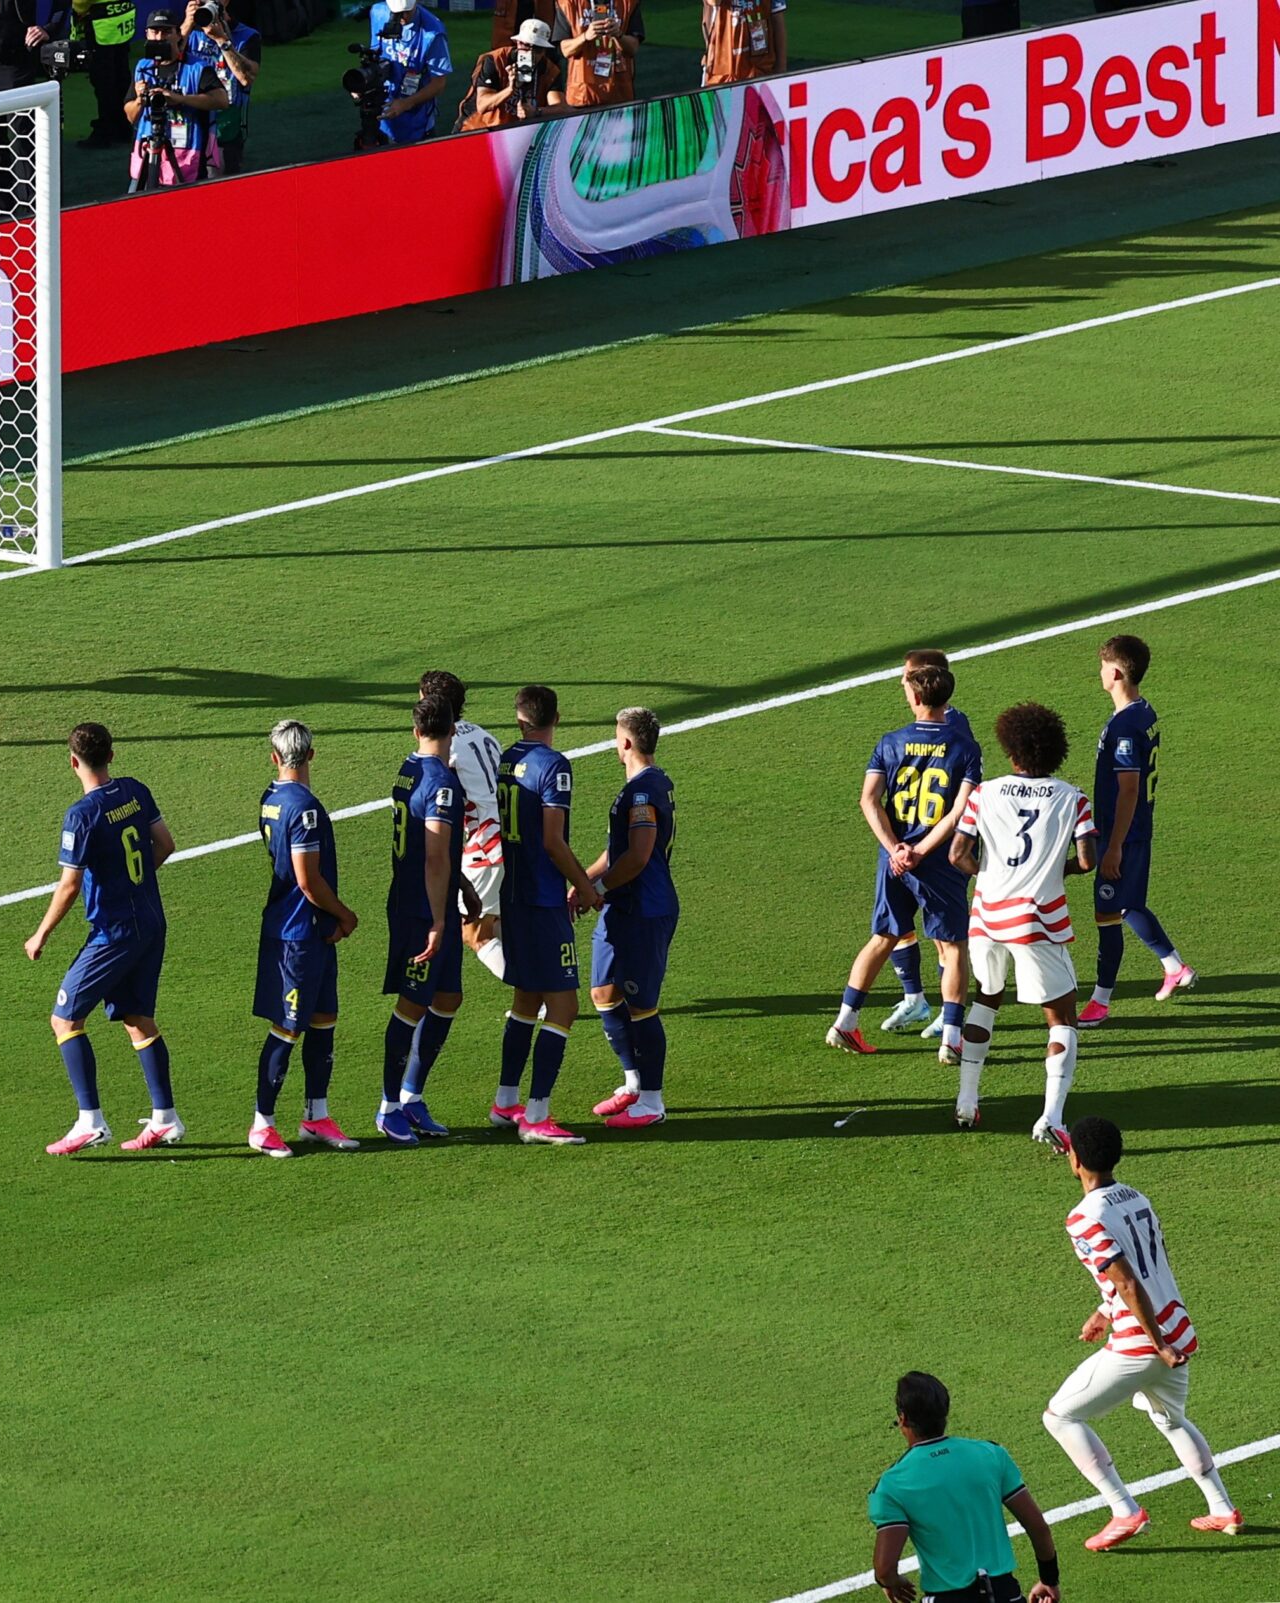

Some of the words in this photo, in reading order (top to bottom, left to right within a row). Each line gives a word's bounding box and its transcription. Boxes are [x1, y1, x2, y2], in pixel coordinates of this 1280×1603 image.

[775, 57, 991, 209] ica's
[1025, 12, 1226, 163] Best
[497, 781, 521, 843] 21
[893, 766, 950, 827] 26
[1000, 783, 1055, 798] RICHARDS
[121, 825, 144, 886] 6
[393, 800, 408, 861] 3
[1007, 808, 1040, 867] 3
[406, 957, 430, 982] 23
[560, 943, 577, 967] 21
[285, 988, 299, 1011] 4
[1123, 1207, 1158, 1280] 17
